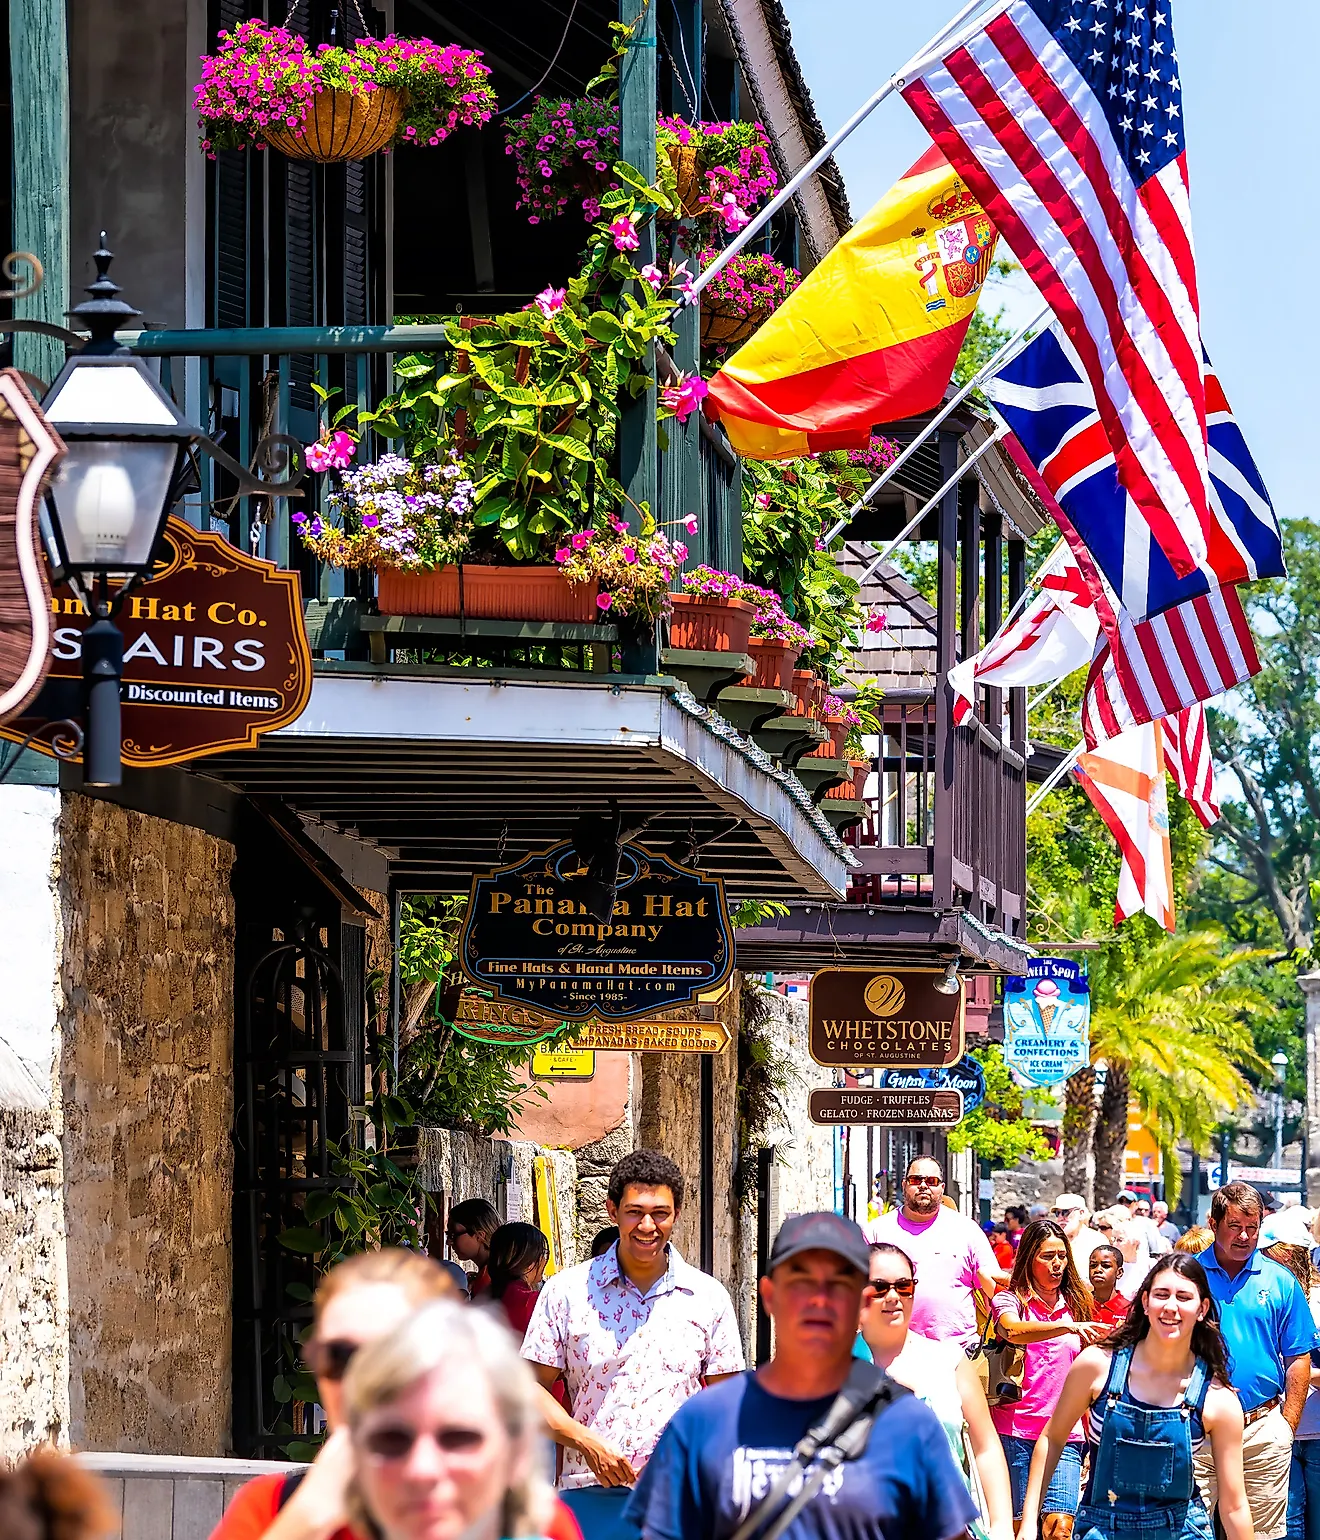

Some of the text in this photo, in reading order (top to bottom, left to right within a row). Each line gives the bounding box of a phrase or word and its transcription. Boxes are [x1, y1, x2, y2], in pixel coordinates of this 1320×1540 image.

[129, 597, 196, 622] Hat
[207, 602, 267, 627] Co.
[52, 628, 266, 672] SAIRS
[128, 684, 278, 709] Discounted Items
[523, 884, 554, 895] The
[488, 892, 709, 917] Panaa Hat
[532, 919, 664, 942] Company
[557, 943, 571, 955] of
[585, 943, 637, 957] Augustine
[488, 962, 703, 976] Fine Hats & Hand Made Items
[1052, 964, 1076, 979] SPOT
[516, 978, 676, 991] MyPanamaHat.com
[569, 992, 596, 1001] Since
[456, 1001, 545, 1028] RINGS
[589, 1023, 702, 1038] FRESH BREAD SOUPS
[822, 1020, 952, 1040] WHETSTONE
[643, 1037, 679, 1049] BAKED
[681, 1038, 718, 1050] GOODS
[827, 1041, 951, 1051] CHOCOLATES
[1014, 1049, 1079, 1057] CONFECTIONS
[888, 1073, 977, 1089] Gypsy Moon
[841, 1096, 930, 1105] FUDGE TRUFFLES
[820, 1109, 954, 1119] GELATO FROZEN BANANAS
